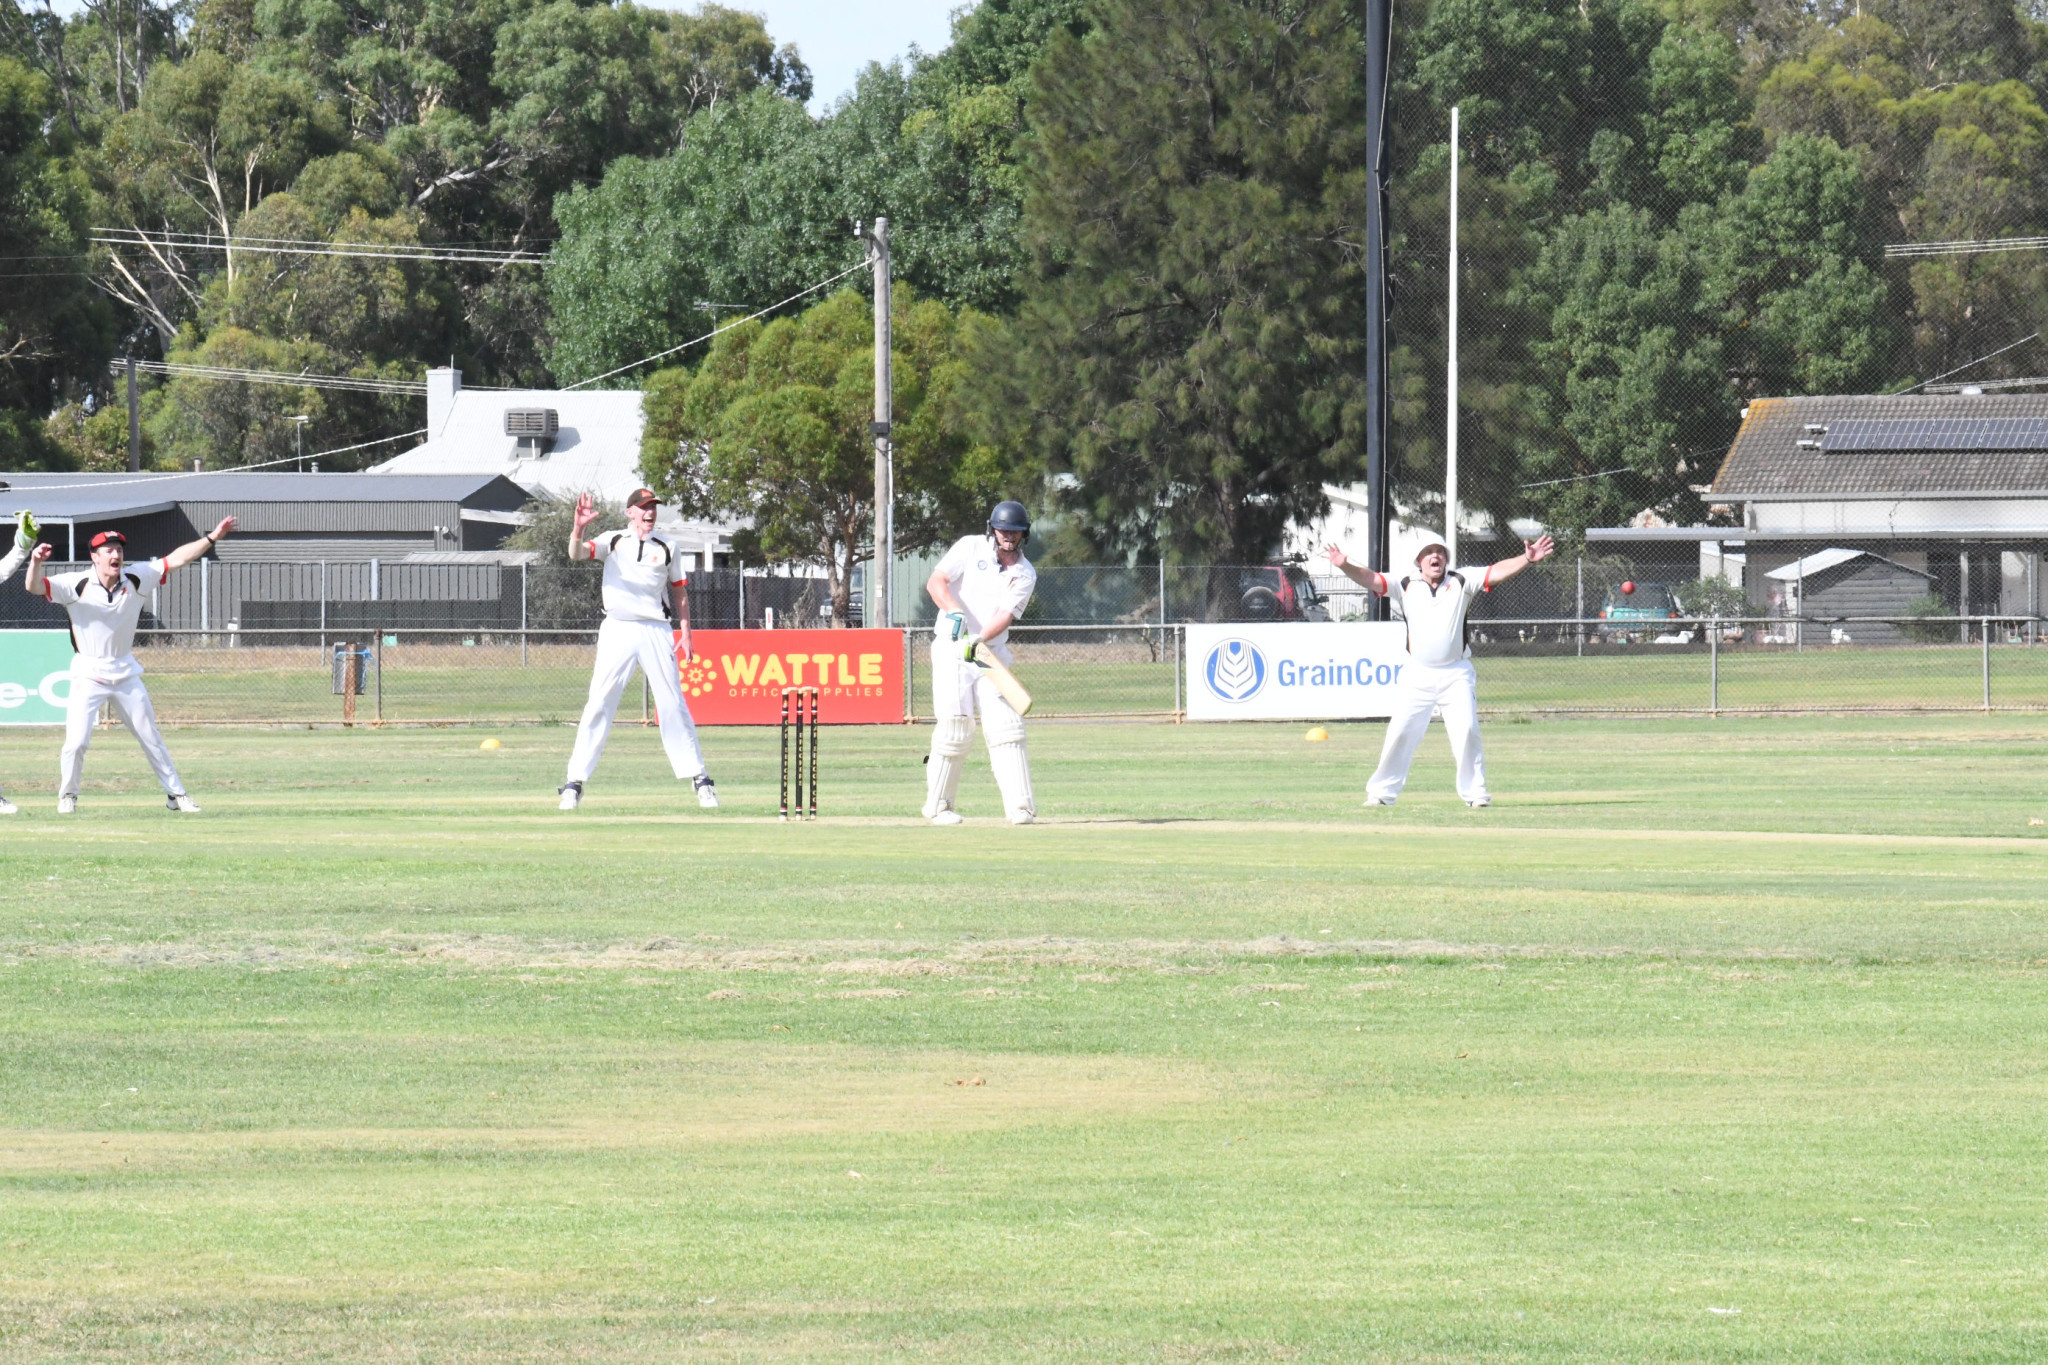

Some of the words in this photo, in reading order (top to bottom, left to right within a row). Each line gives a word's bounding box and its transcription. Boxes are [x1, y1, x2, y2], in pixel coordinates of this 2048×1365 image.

[721, 653, 883, 686] WATTLE
[1277, 658, 1404, 687] GrainCor
[729, 688, 784, 698] OFFIC
[801, 687, 884, 698] PPLIES
